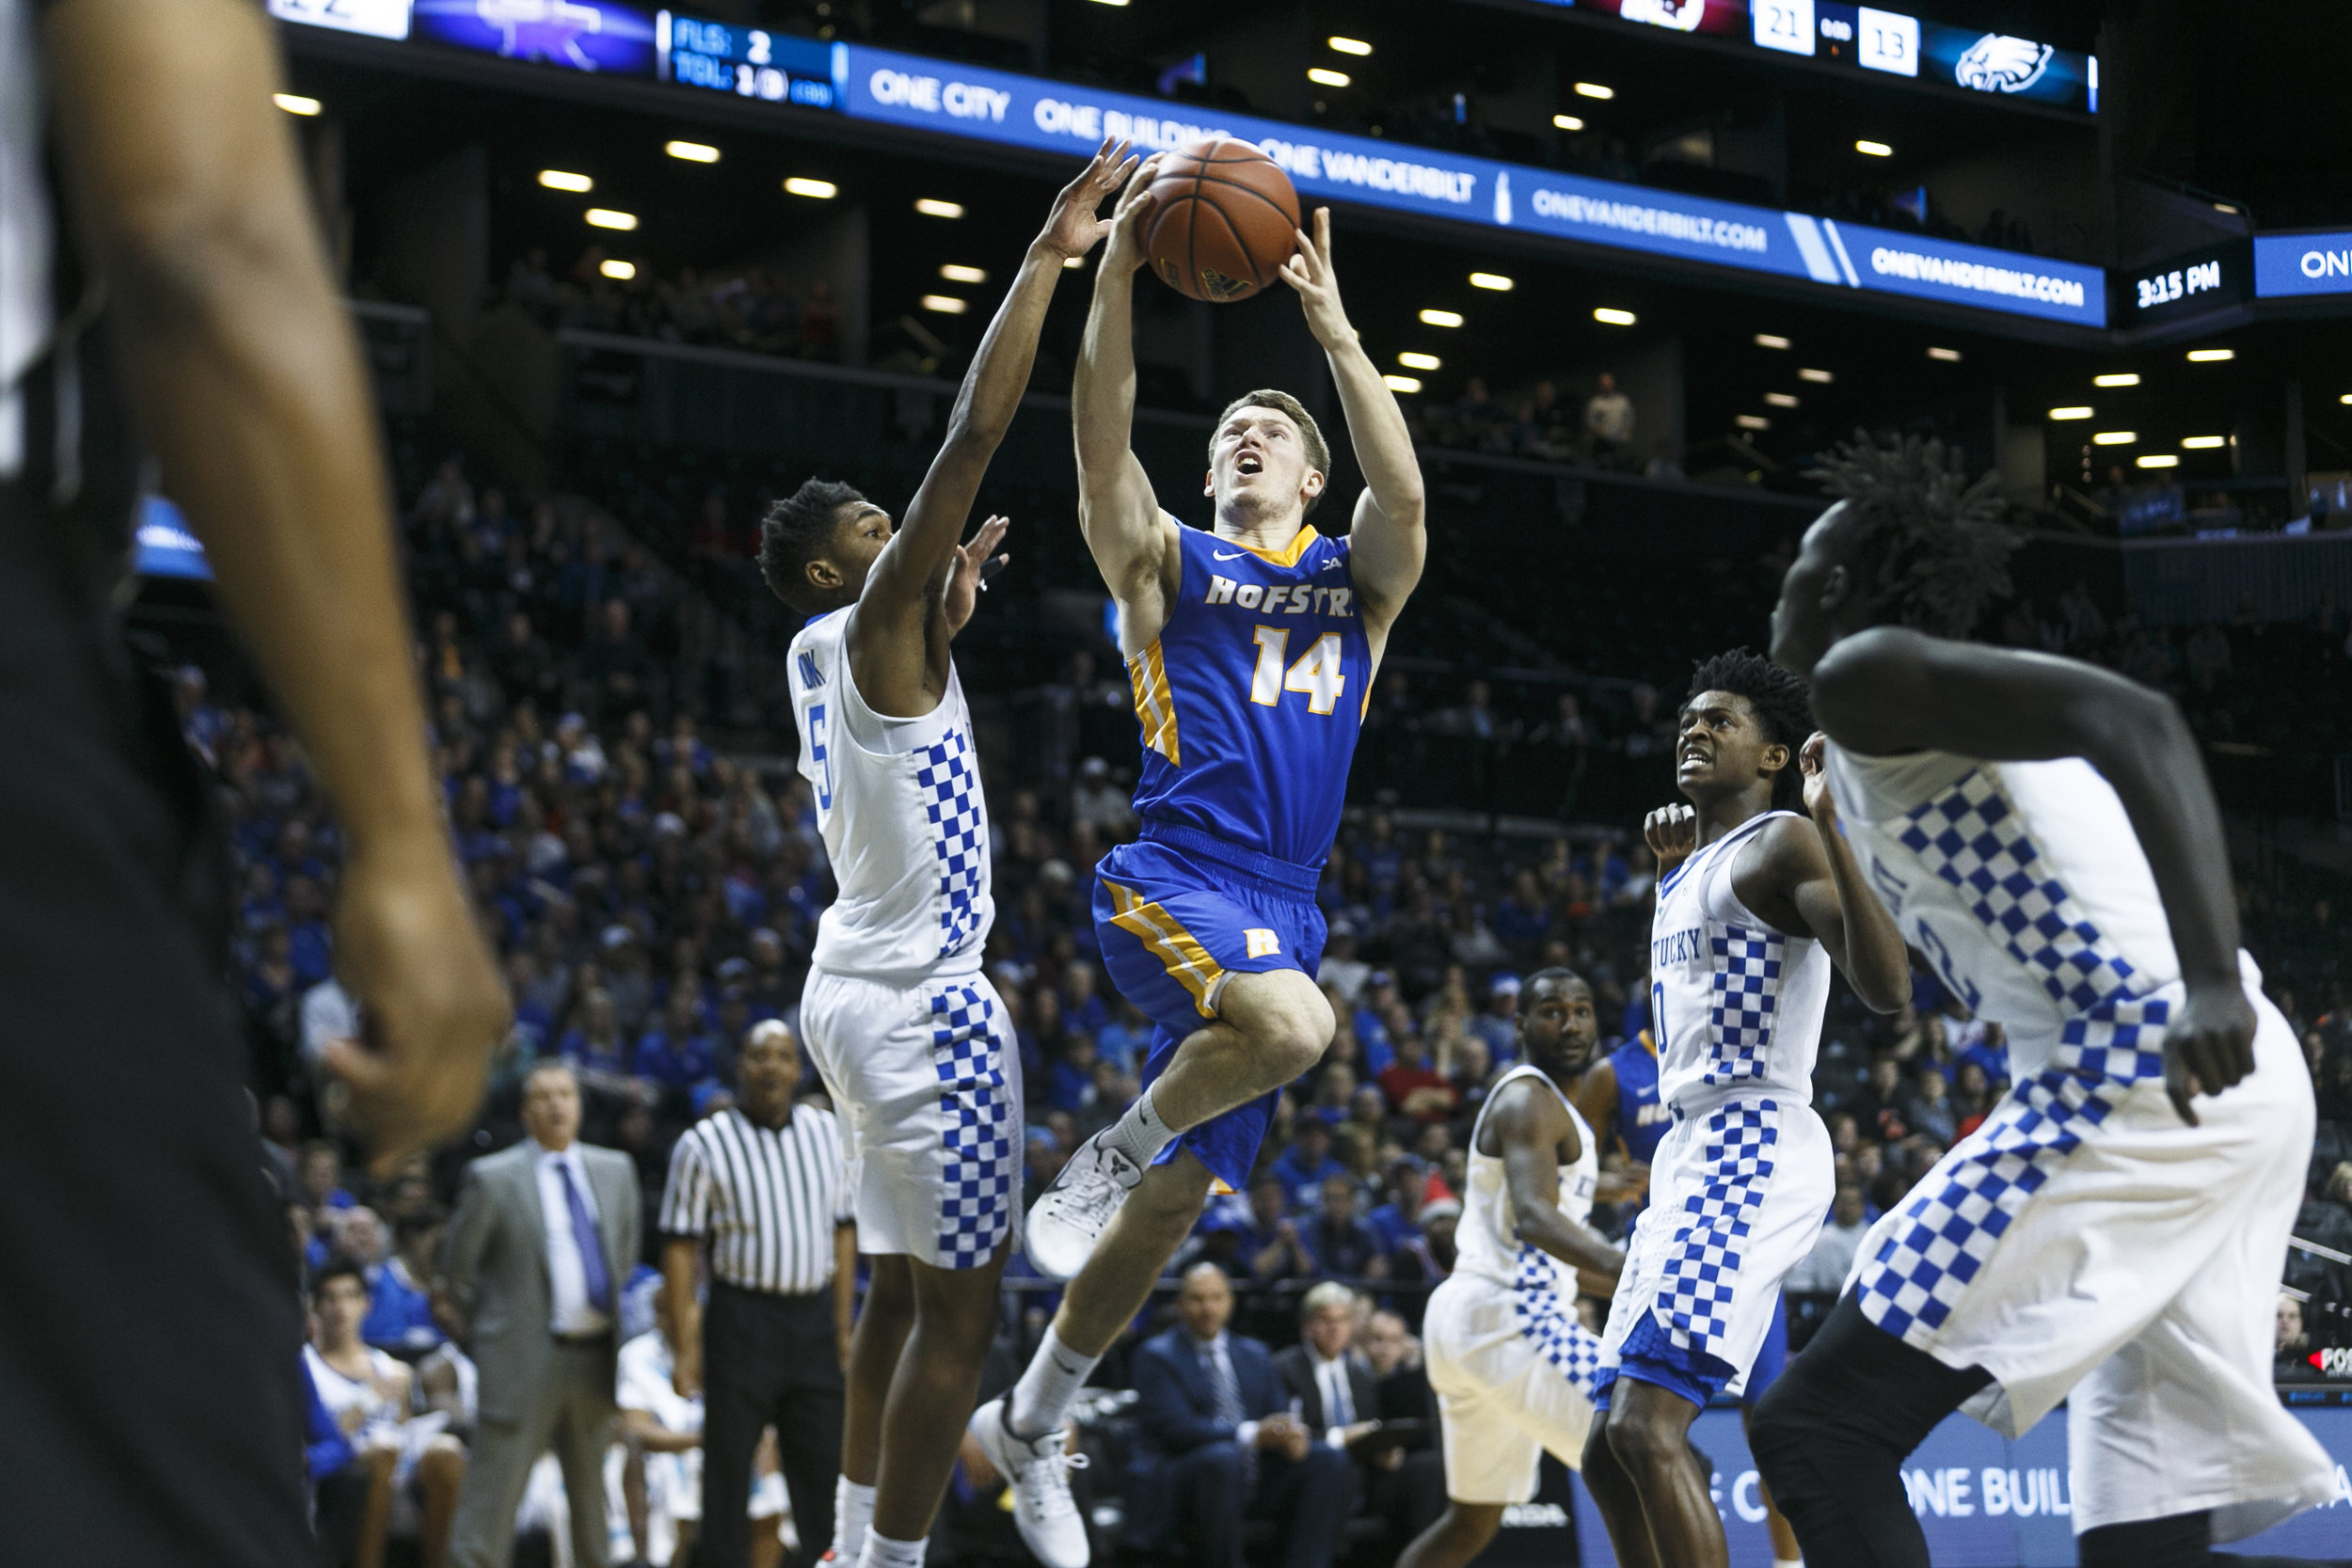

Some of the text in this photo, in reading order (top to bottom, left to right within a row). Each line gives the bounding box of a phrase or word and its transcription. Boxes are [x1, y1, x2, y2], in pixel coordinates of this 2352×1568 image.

[1770, 6, 1798, 38] 21
[1875, 28, 1904, 59] 13
[747, 30, 771, 64] 2
[870, 69, 940, 113] ONE
[943, 82, 1010, 123] CITY
[1034, 99, 1103, 141] ONE
[1321, 149, 1476, 204] VANDERBILT
[1533, 189, 1767, 253] ONEVANDERBILT.COM
[1871, 247, 2084, 307] ONEVANDERBILT.COM
[2137, 261, 2220, 309] 3:15 PM
[2301, 249, 2352, 278] ON
[1205, 575, 1353, 617] HOFSTR
[1250, 625, 1345, 715] 14
[809, 705, 832, 810] 5
[1242, 927, 1281, 959] H
[1653, 981, 1668, 1054] 0
[1980, 1467, 2074, 1517] BUIL
